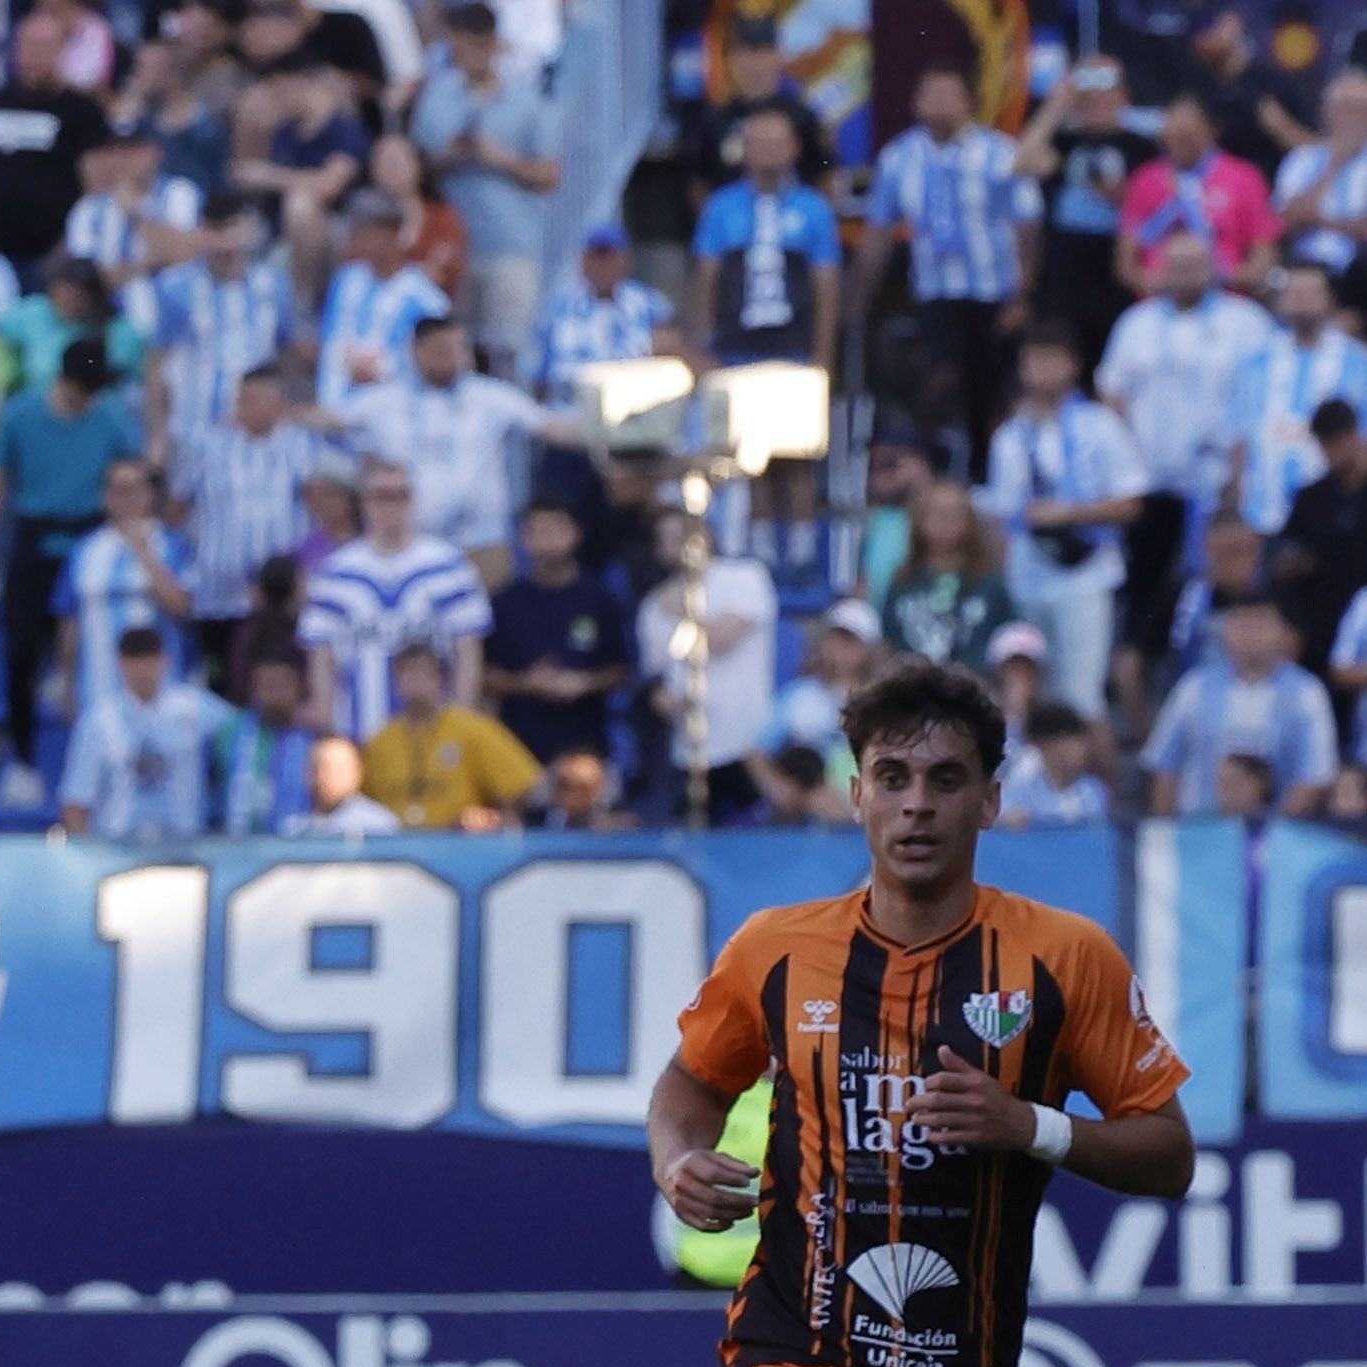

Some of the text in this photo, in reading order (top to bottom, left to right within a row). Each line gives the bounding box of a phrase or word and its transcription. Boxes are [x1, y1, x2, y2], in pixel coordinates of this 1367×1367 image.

[839, 1045, 907, 1070] sabor
[839, 1070, 858, 1092] a
[841, 1097, 970, 1171] lag
[853, 1314, 958, 1348] Fundación
